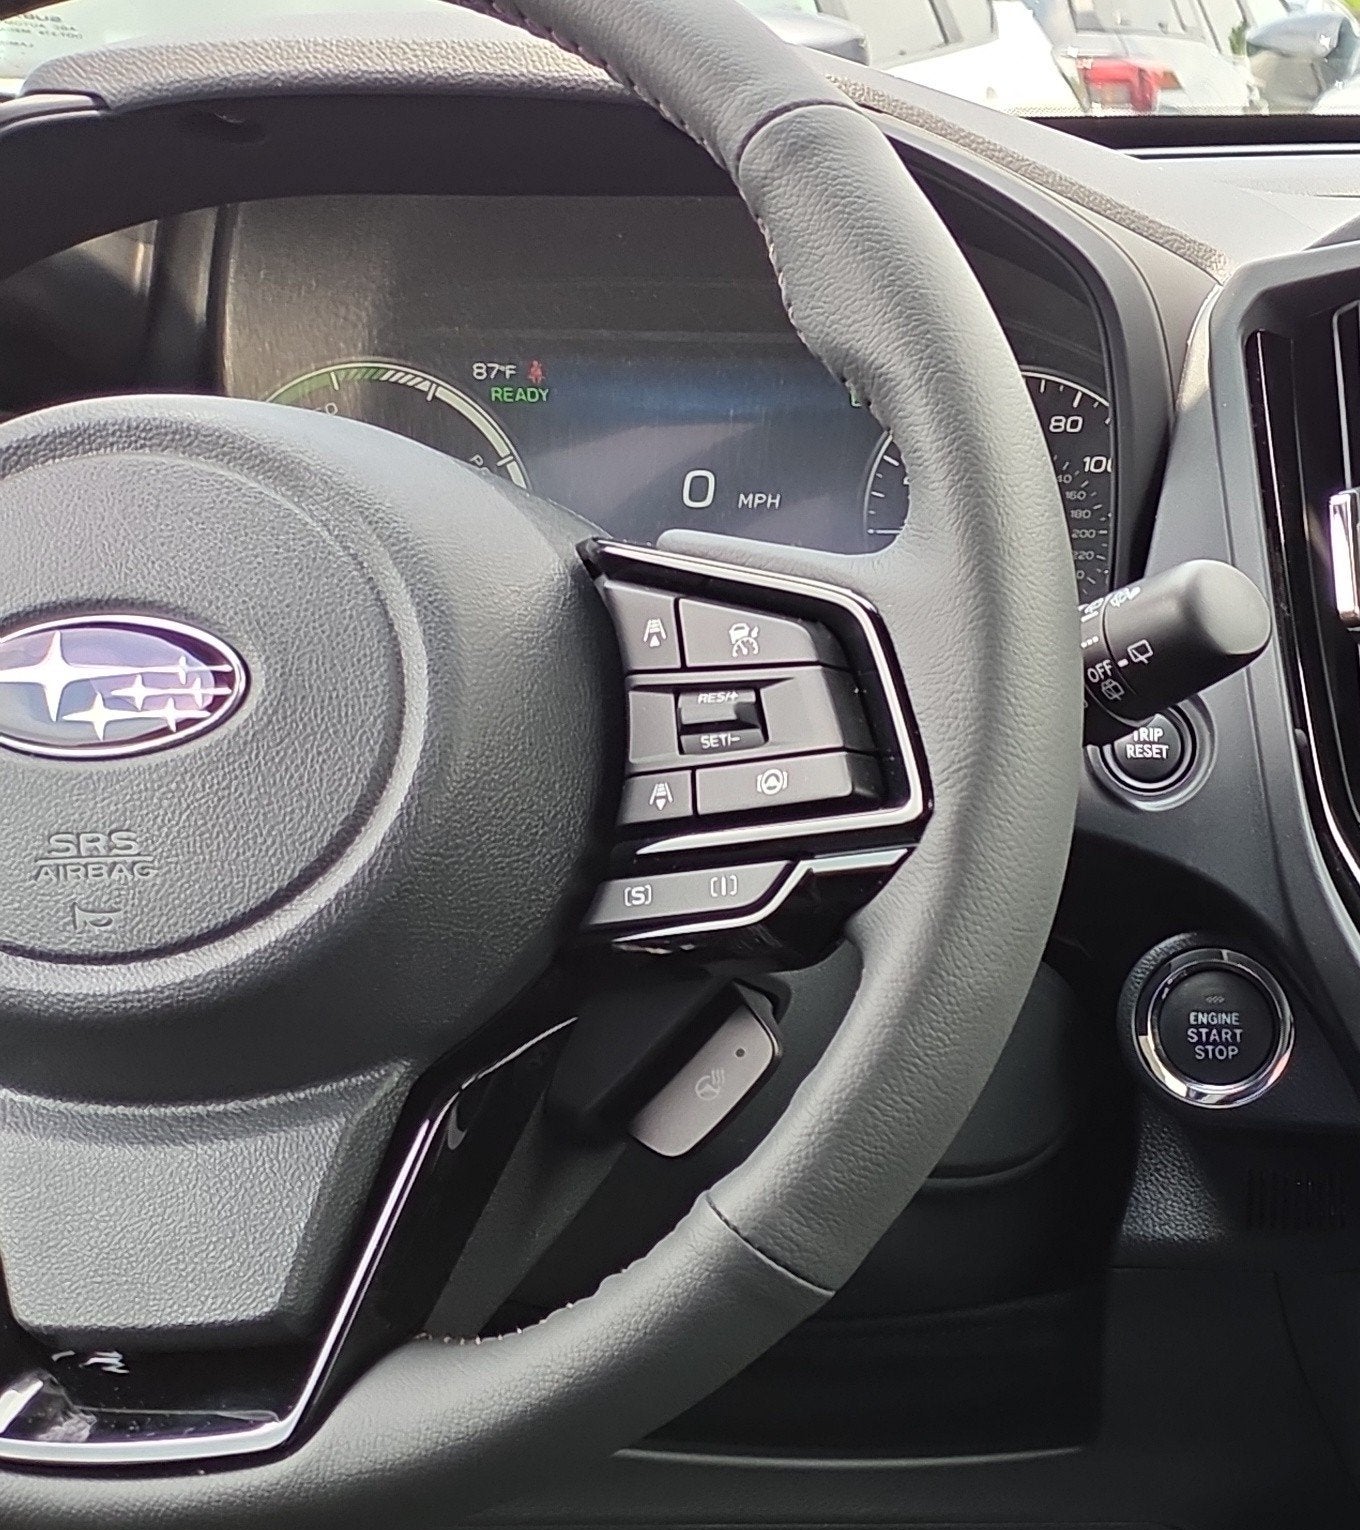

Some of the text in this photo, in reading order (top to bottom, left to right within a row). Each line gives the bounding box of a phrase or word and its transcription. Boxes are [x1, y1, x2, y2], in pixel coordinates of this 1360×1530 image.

[491, 387, 549, 402] READY
[1049, 416, 1083, 433] 80
[682, 469, 715, 508] 0
[738, 493, 781, 510] MPH
[1072, 529, 1096, 539] 200
[1087, 659, 1112, 683] OFF
[1126, 744, 1169, 759] RESET
[48, 830, 141, 857] SRS
[32, 860, 158, 883] AIRBAG
[1189, 1011, 1240, 1025] ENGINE
[1187, 1028, 1243, 1043] START
[1194, 1045, 1239, 1060] STOP
